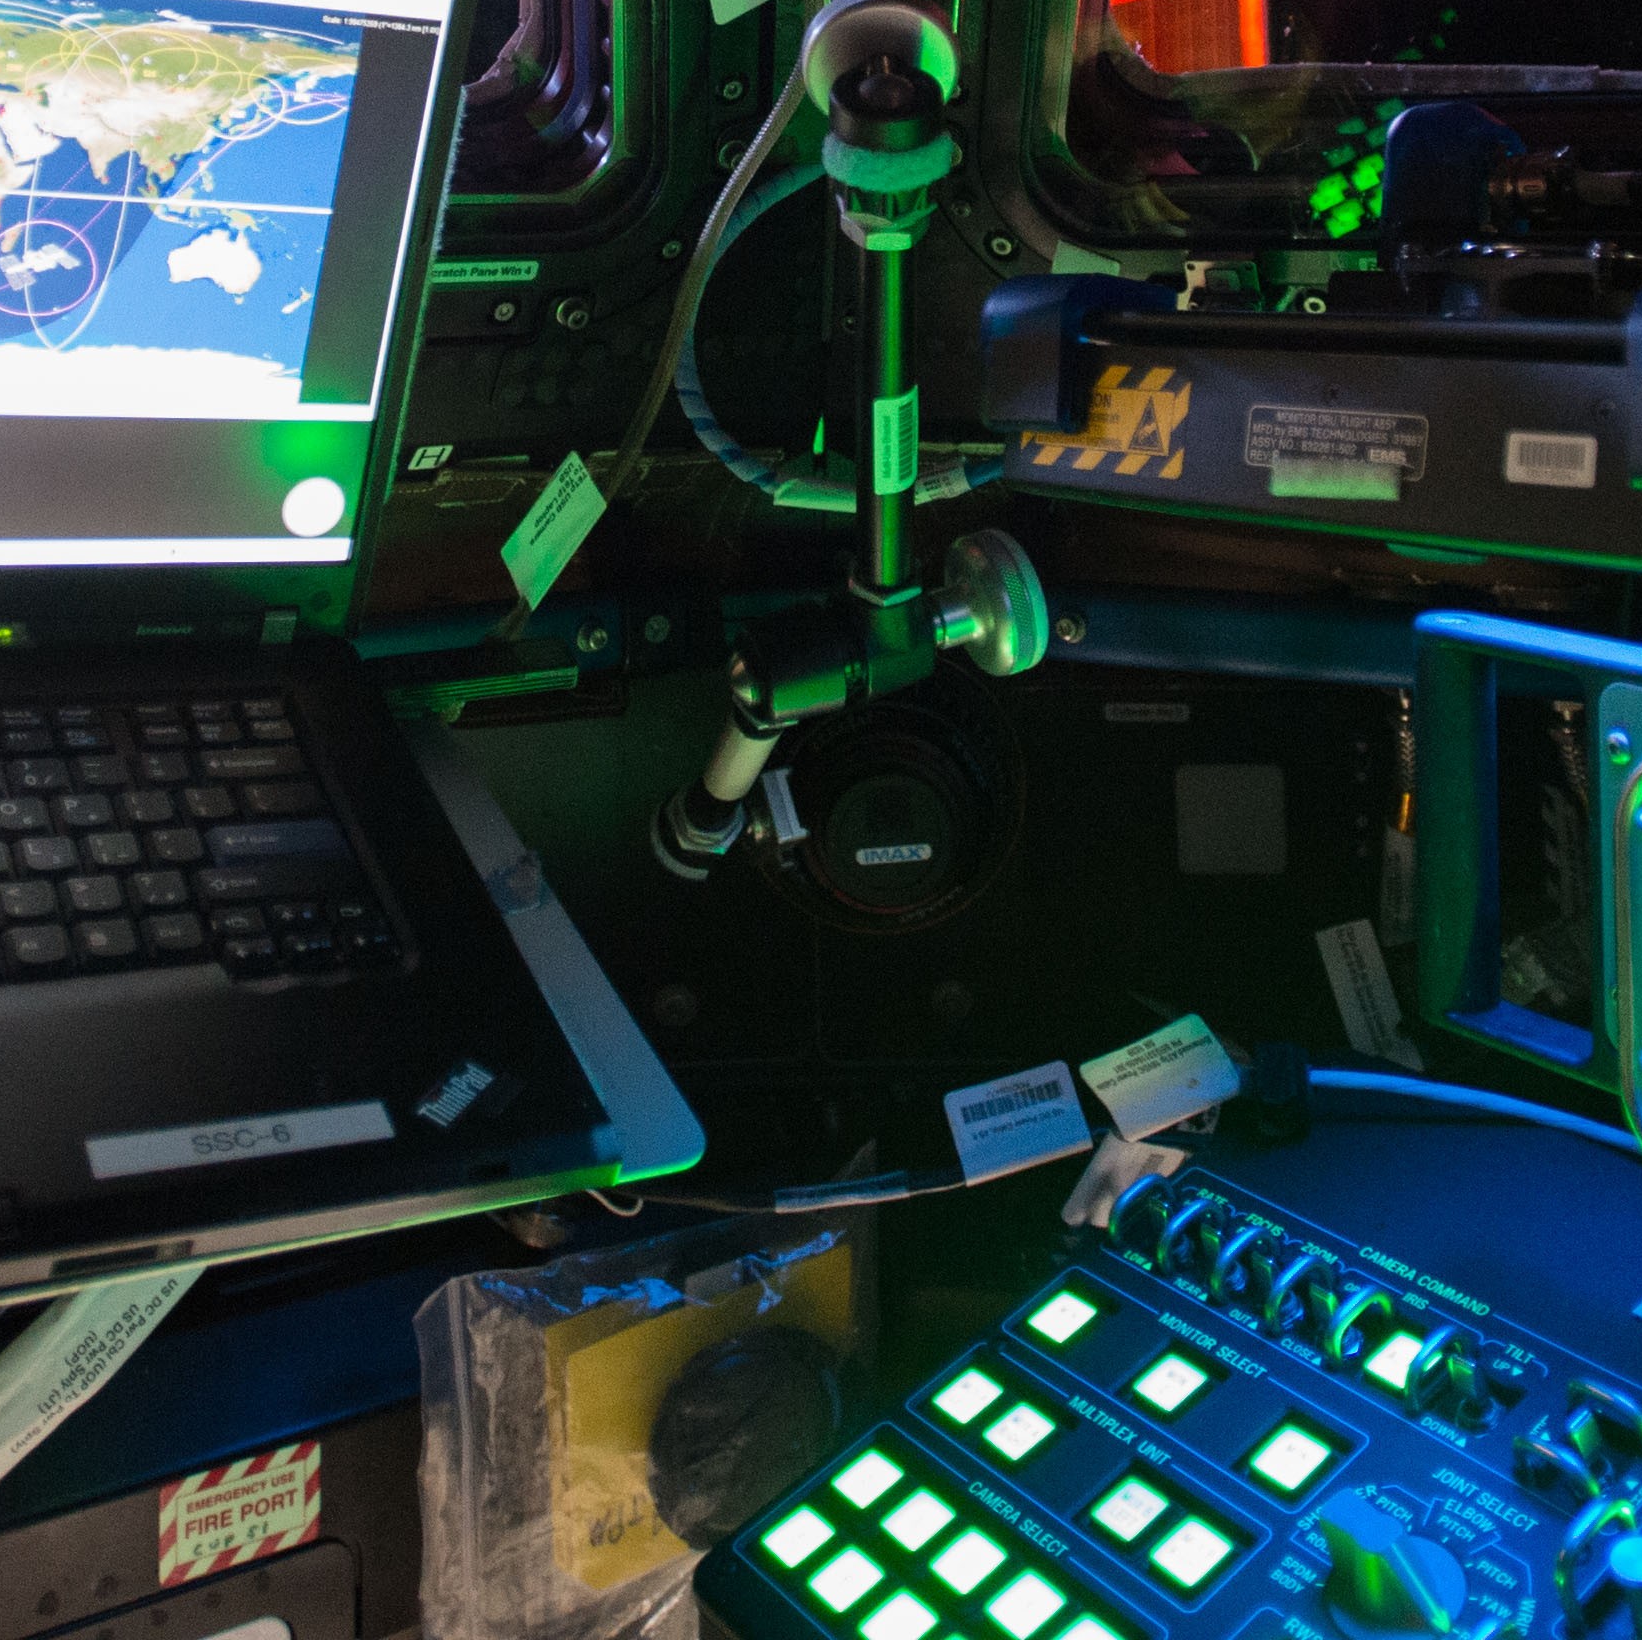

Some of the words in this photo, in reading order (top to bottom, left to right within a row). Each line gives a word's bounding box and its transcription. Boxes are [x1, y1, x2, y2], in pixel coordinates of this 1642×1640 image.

[432, 265, 468, 278] cratch
[470, 266, 498, 277] Pane
[500, 266, 522, 277] Win
[524, 267, 532, 276] 4
[1311, 427, 1388, 443] TECHNOLOGIES
[415, 448, 446, 467] H
[864, 845, 923, 862] IMAX
[417, 1060, 496, 1128] ThinkPad
[1244, 1213, 1286, 1239] FOCUS
[160, 1277, 178, 1296] US
[1359, 1246, 1417, 1282] CAMERA
[1417, 1275, 1491, 1317] COMMAND
[121, 1302, 140, 1322] US
[143, 1295, 163, 1316] DC
[1402, 1291, 1430, 1311] IRIS
[124, 1314, 146, 1339] Pwr
[1229, 1307, 1251, 1327] OUT
[104, 1321, 124, 1342] DC
[1158, 1311, 1217, 1351] MONITOR
[1216, 1345, 1268, 1379] SELECT
[64, 1329, 97, 1367] (UOP)
[83, 1339, 107, 1366] Pwr
[105, 1337, 127, 1361] Cbl
[1280, 1337, 1315, 1362] CLOSE
[1504, 1343, 1536, 1365] TILT
[59, 1363, 85, 1391] Sply
[77, 1358, 107, 1392] (UOP
[1492, 1359, 1511, 1374] UP
[1067, 1395, 1138, 1446] MULTIPLEX
[1136, 1440, 1172, 1467] UNIT
[1420, 1414, 1460, 1444] DOWN
[187, 1480, 268, 1513] EMERGENCY
[271, 1470, 296, 1487] USE
[1431, 1466, 1475, 1499] JOINT
[1475, 1491, 1540, 1534] SELECT
[185, 1508, 234, 1540] FIRE
[240, 1488, 299, 1522] PORT
[968, 1481, 1022, 1526] CAMERA
[1019, 1518, 1069, 1558] SELECT
[1375, 1496, 1414, 1525] PITCH
[1443, 1498, 1497, 1533] ELBOW
[1436, 1515, 1477, 1543] PITCH
[1269, 1567, 1306, 1594] BODY
[1280, 1555, 1318, 1582] SPDM
[1477, 1560, 1519, 1590] PITCH
[1480, 1594, 1514, 1619] YAW
